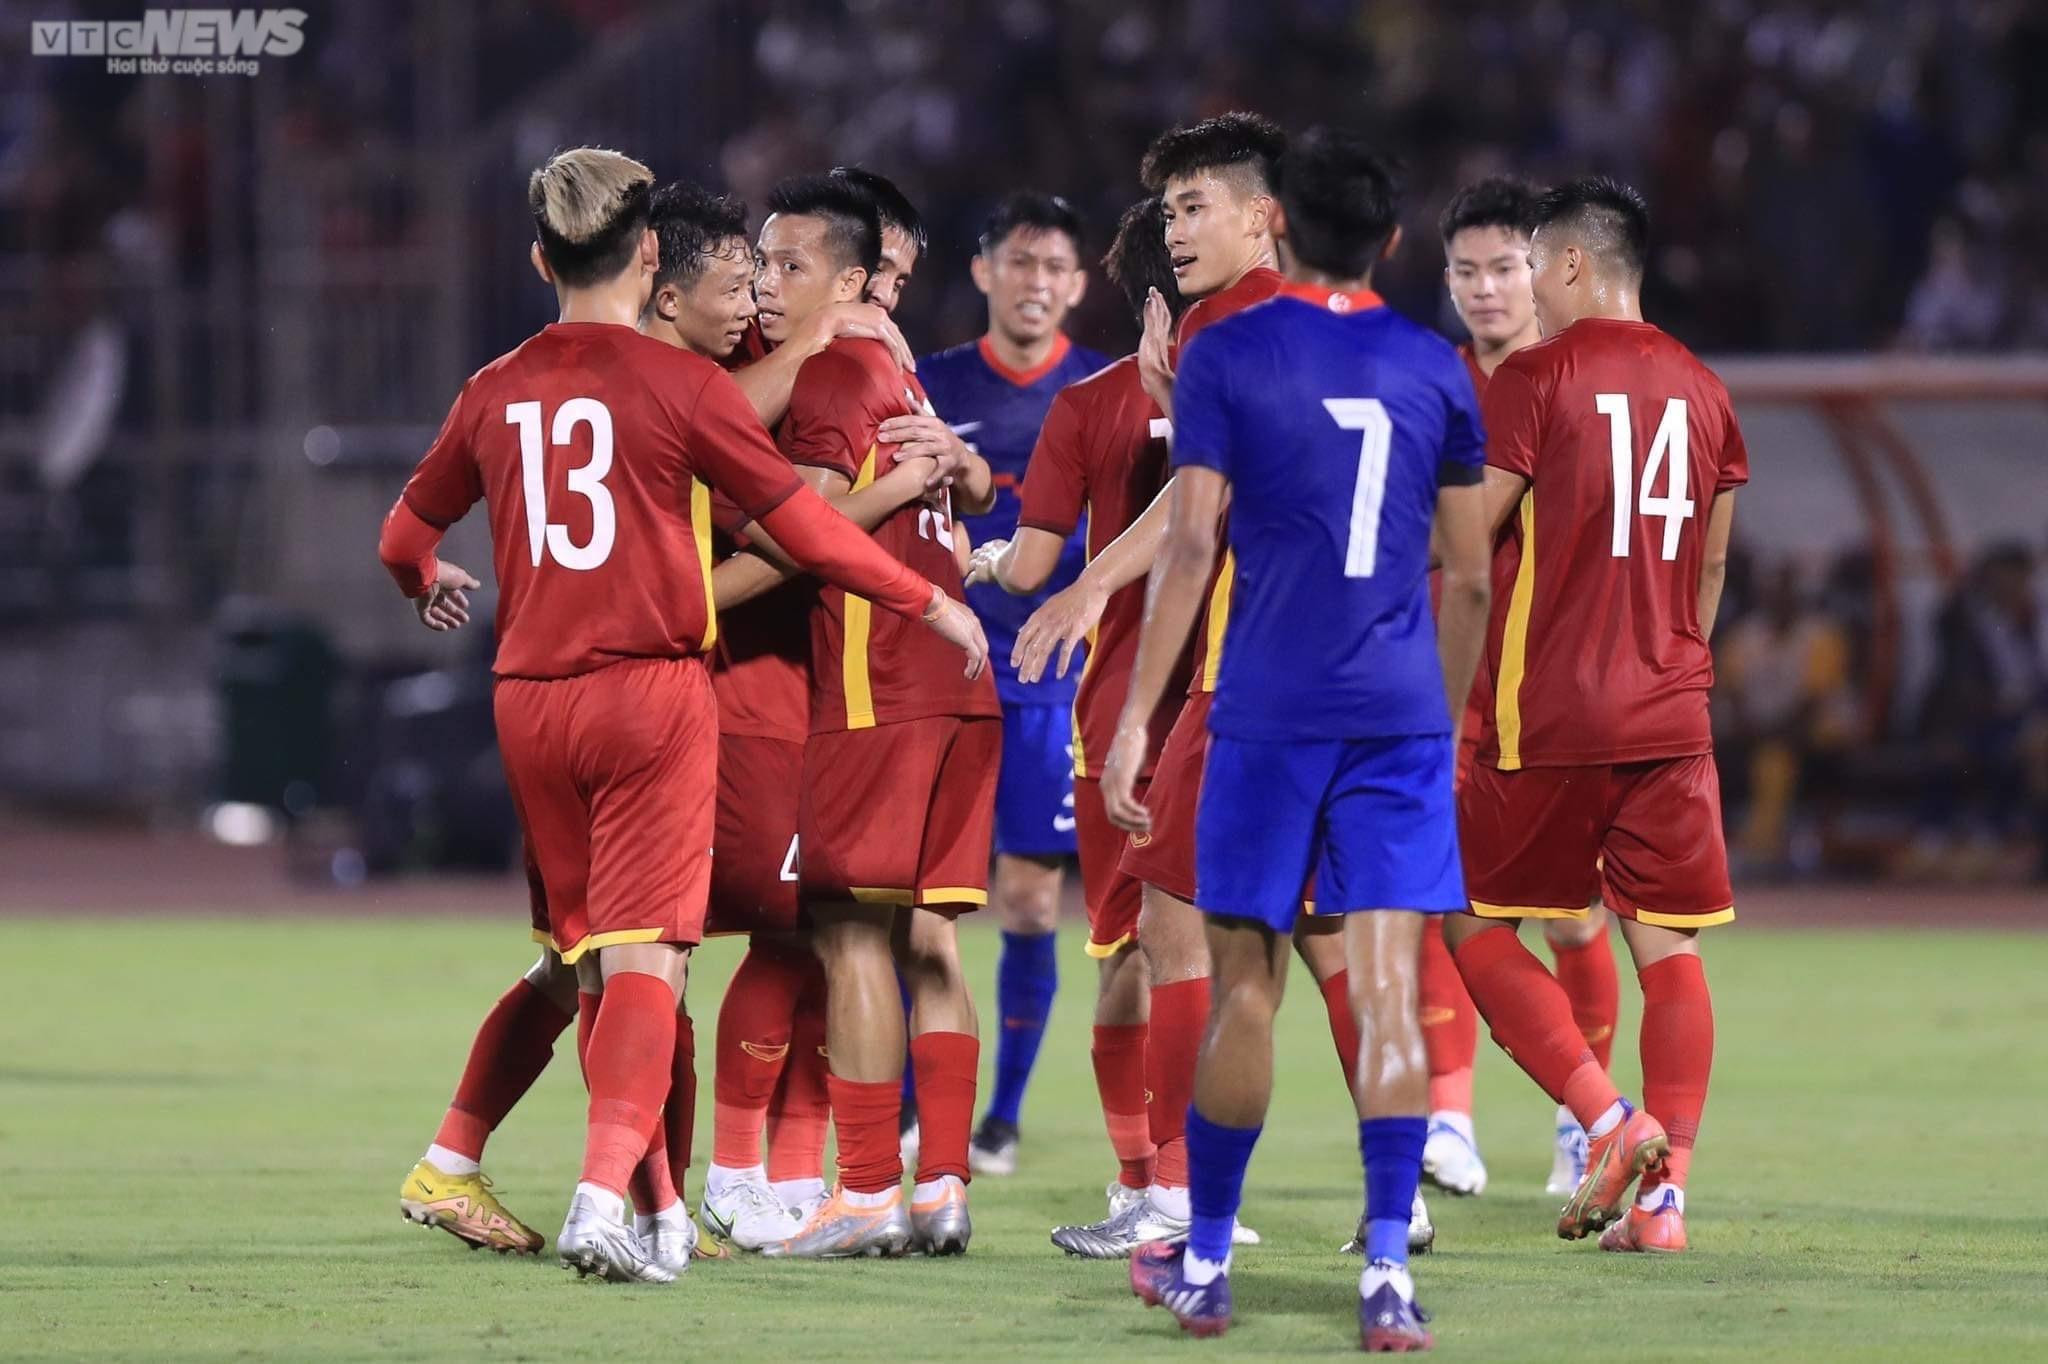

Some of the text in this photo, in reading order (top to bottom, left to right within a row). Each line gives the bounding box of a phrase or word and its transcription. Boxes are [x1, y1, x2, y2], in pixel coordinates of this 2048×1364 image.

[505, 398, 616, 570] 13
[1322, 398, 1392, 578] 7
[1595, 393, 1695, 561] 14
